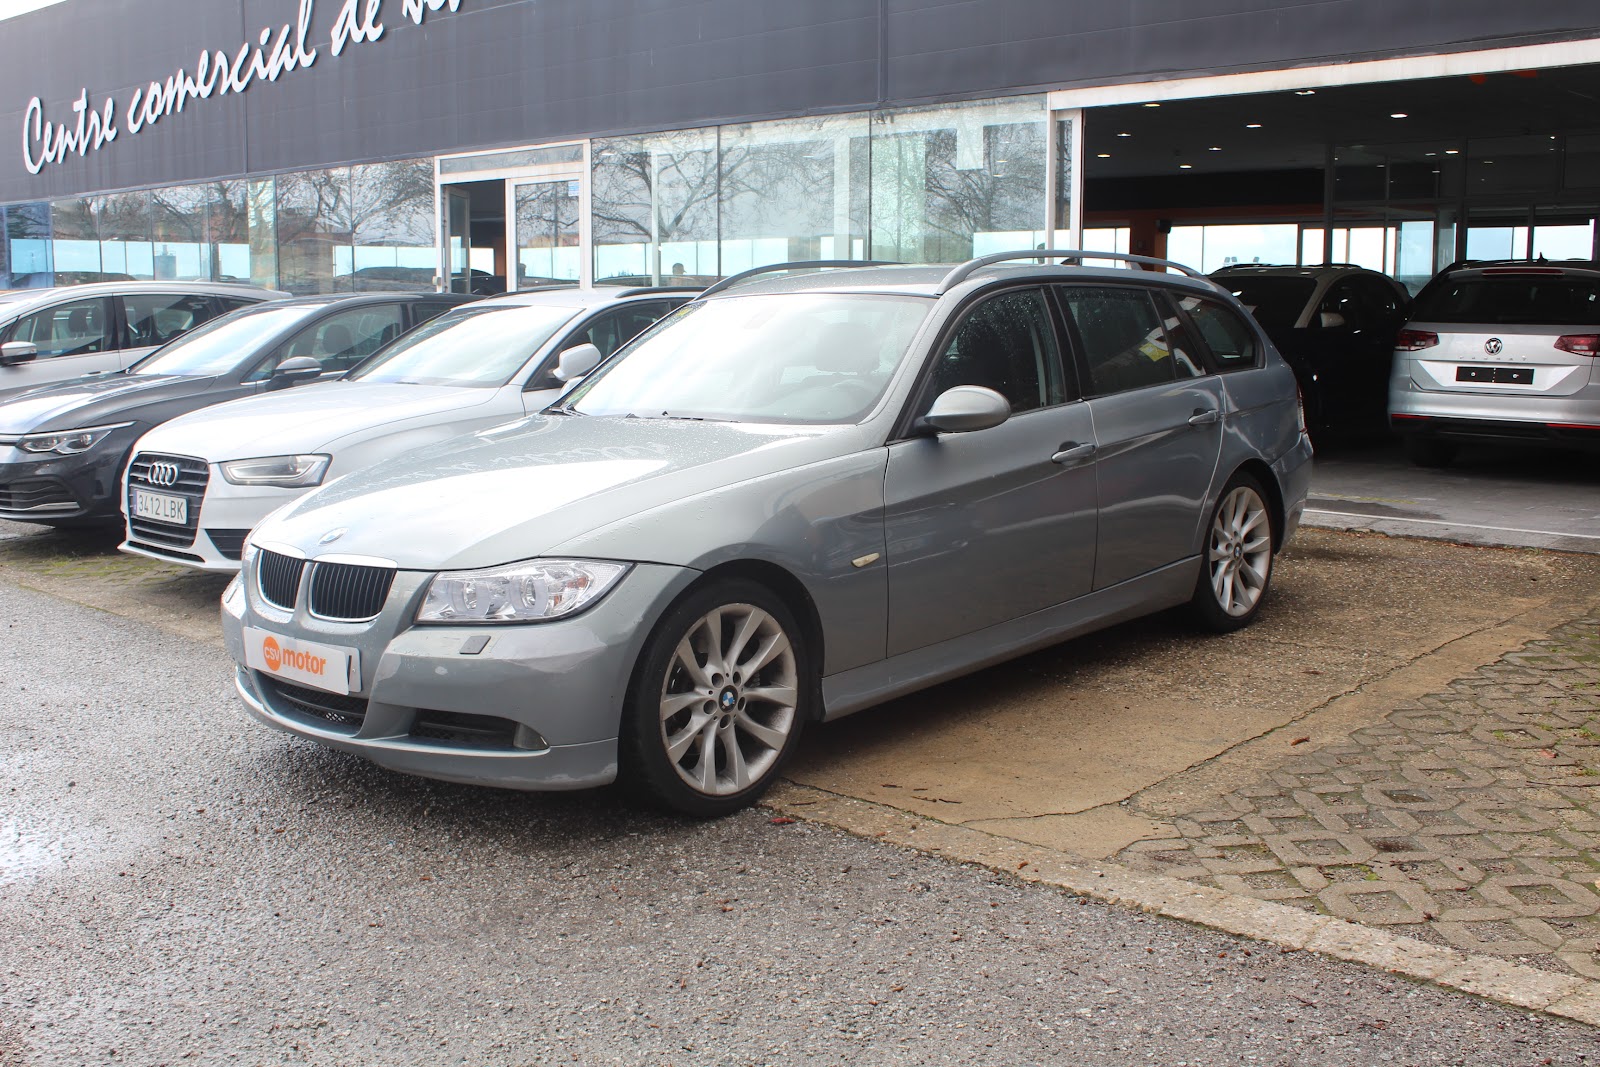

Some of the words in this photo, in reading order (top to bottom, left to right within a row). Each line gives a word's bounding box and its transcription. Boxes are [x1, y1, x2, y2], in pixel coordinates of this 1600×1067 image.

[22, 87, 118, 175] Centre
[126, 0, 317, 134] comercial
[330, 0, 384, 57] de
[138, 494, 161, 516] 3412
[163, 498, 184, 520] LBK
[282, 648, 327, 676] motor
